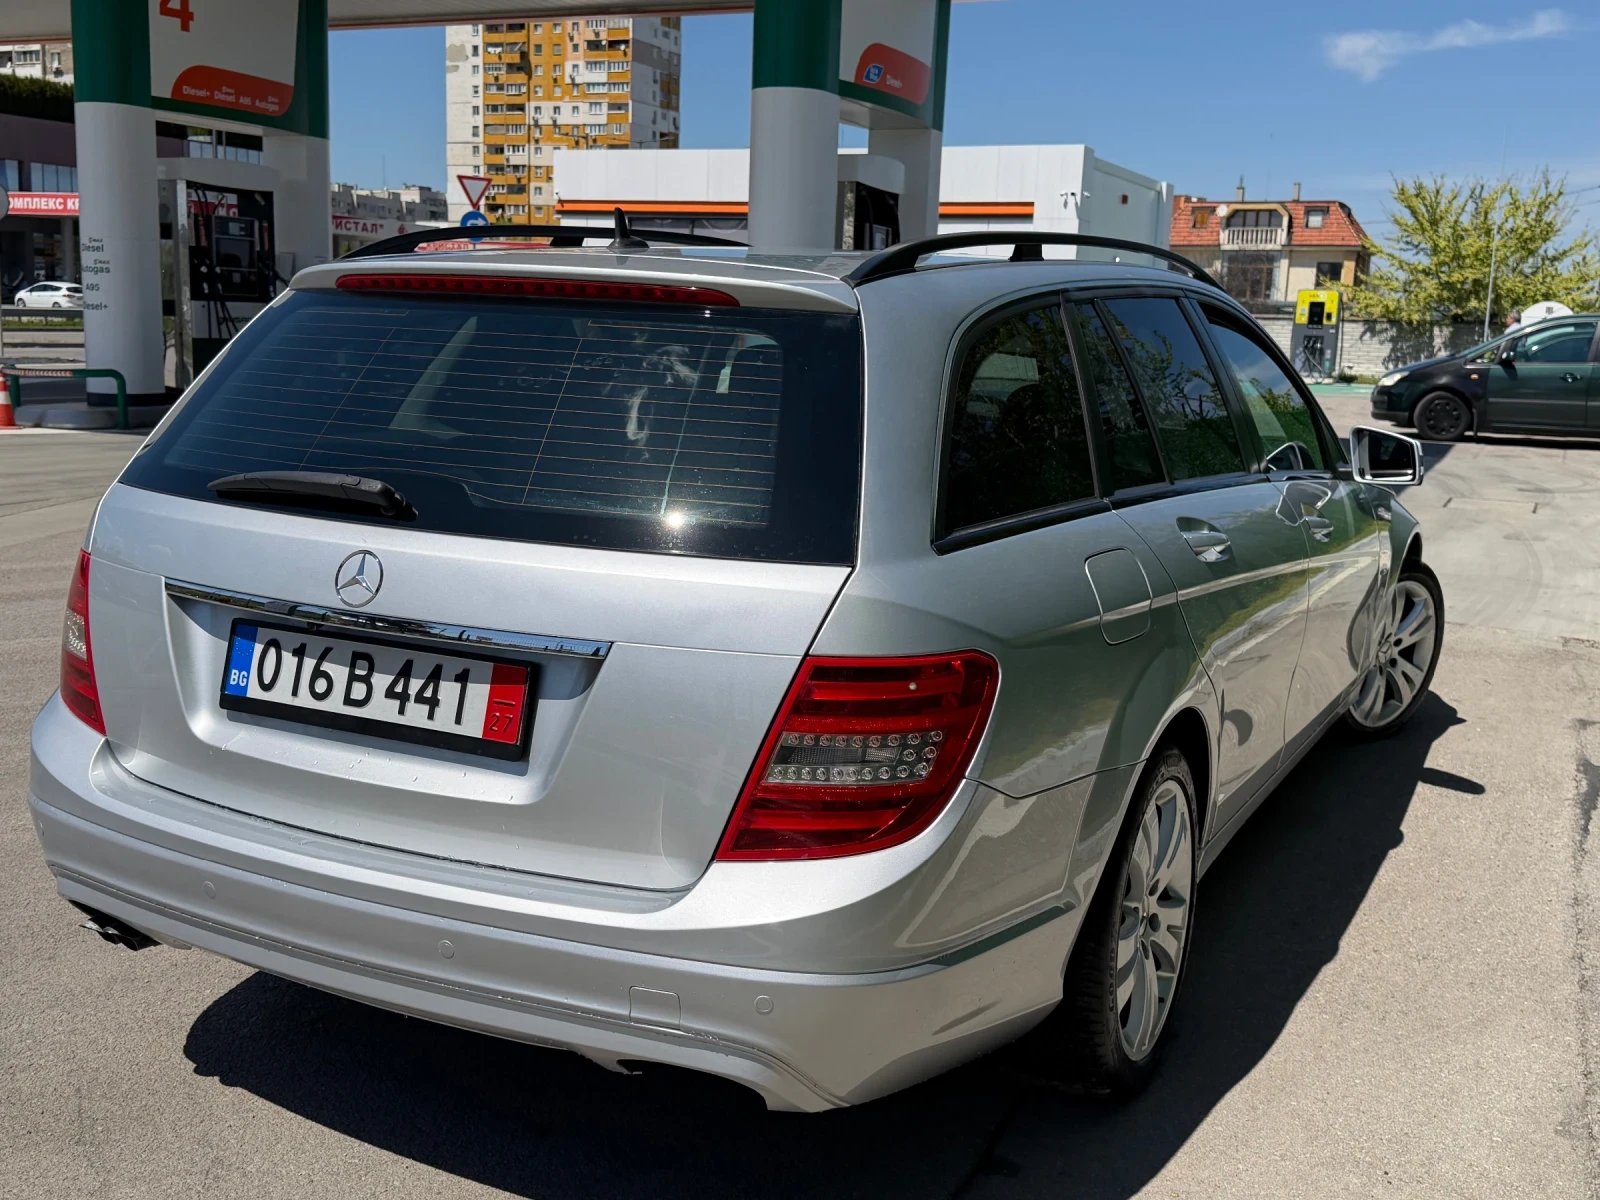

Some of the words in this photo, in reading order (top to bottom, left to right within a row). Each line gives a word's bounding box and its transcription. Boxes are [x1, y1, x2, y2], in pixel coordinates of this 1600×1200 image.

[160, 0, 194, 32] 4
[332, 219, 384, 235] ИСТАЛ"
[86, 283, 100, 291] A95
[229, 668, 249, 687] BG
[488, 712, 514, 733] 27
